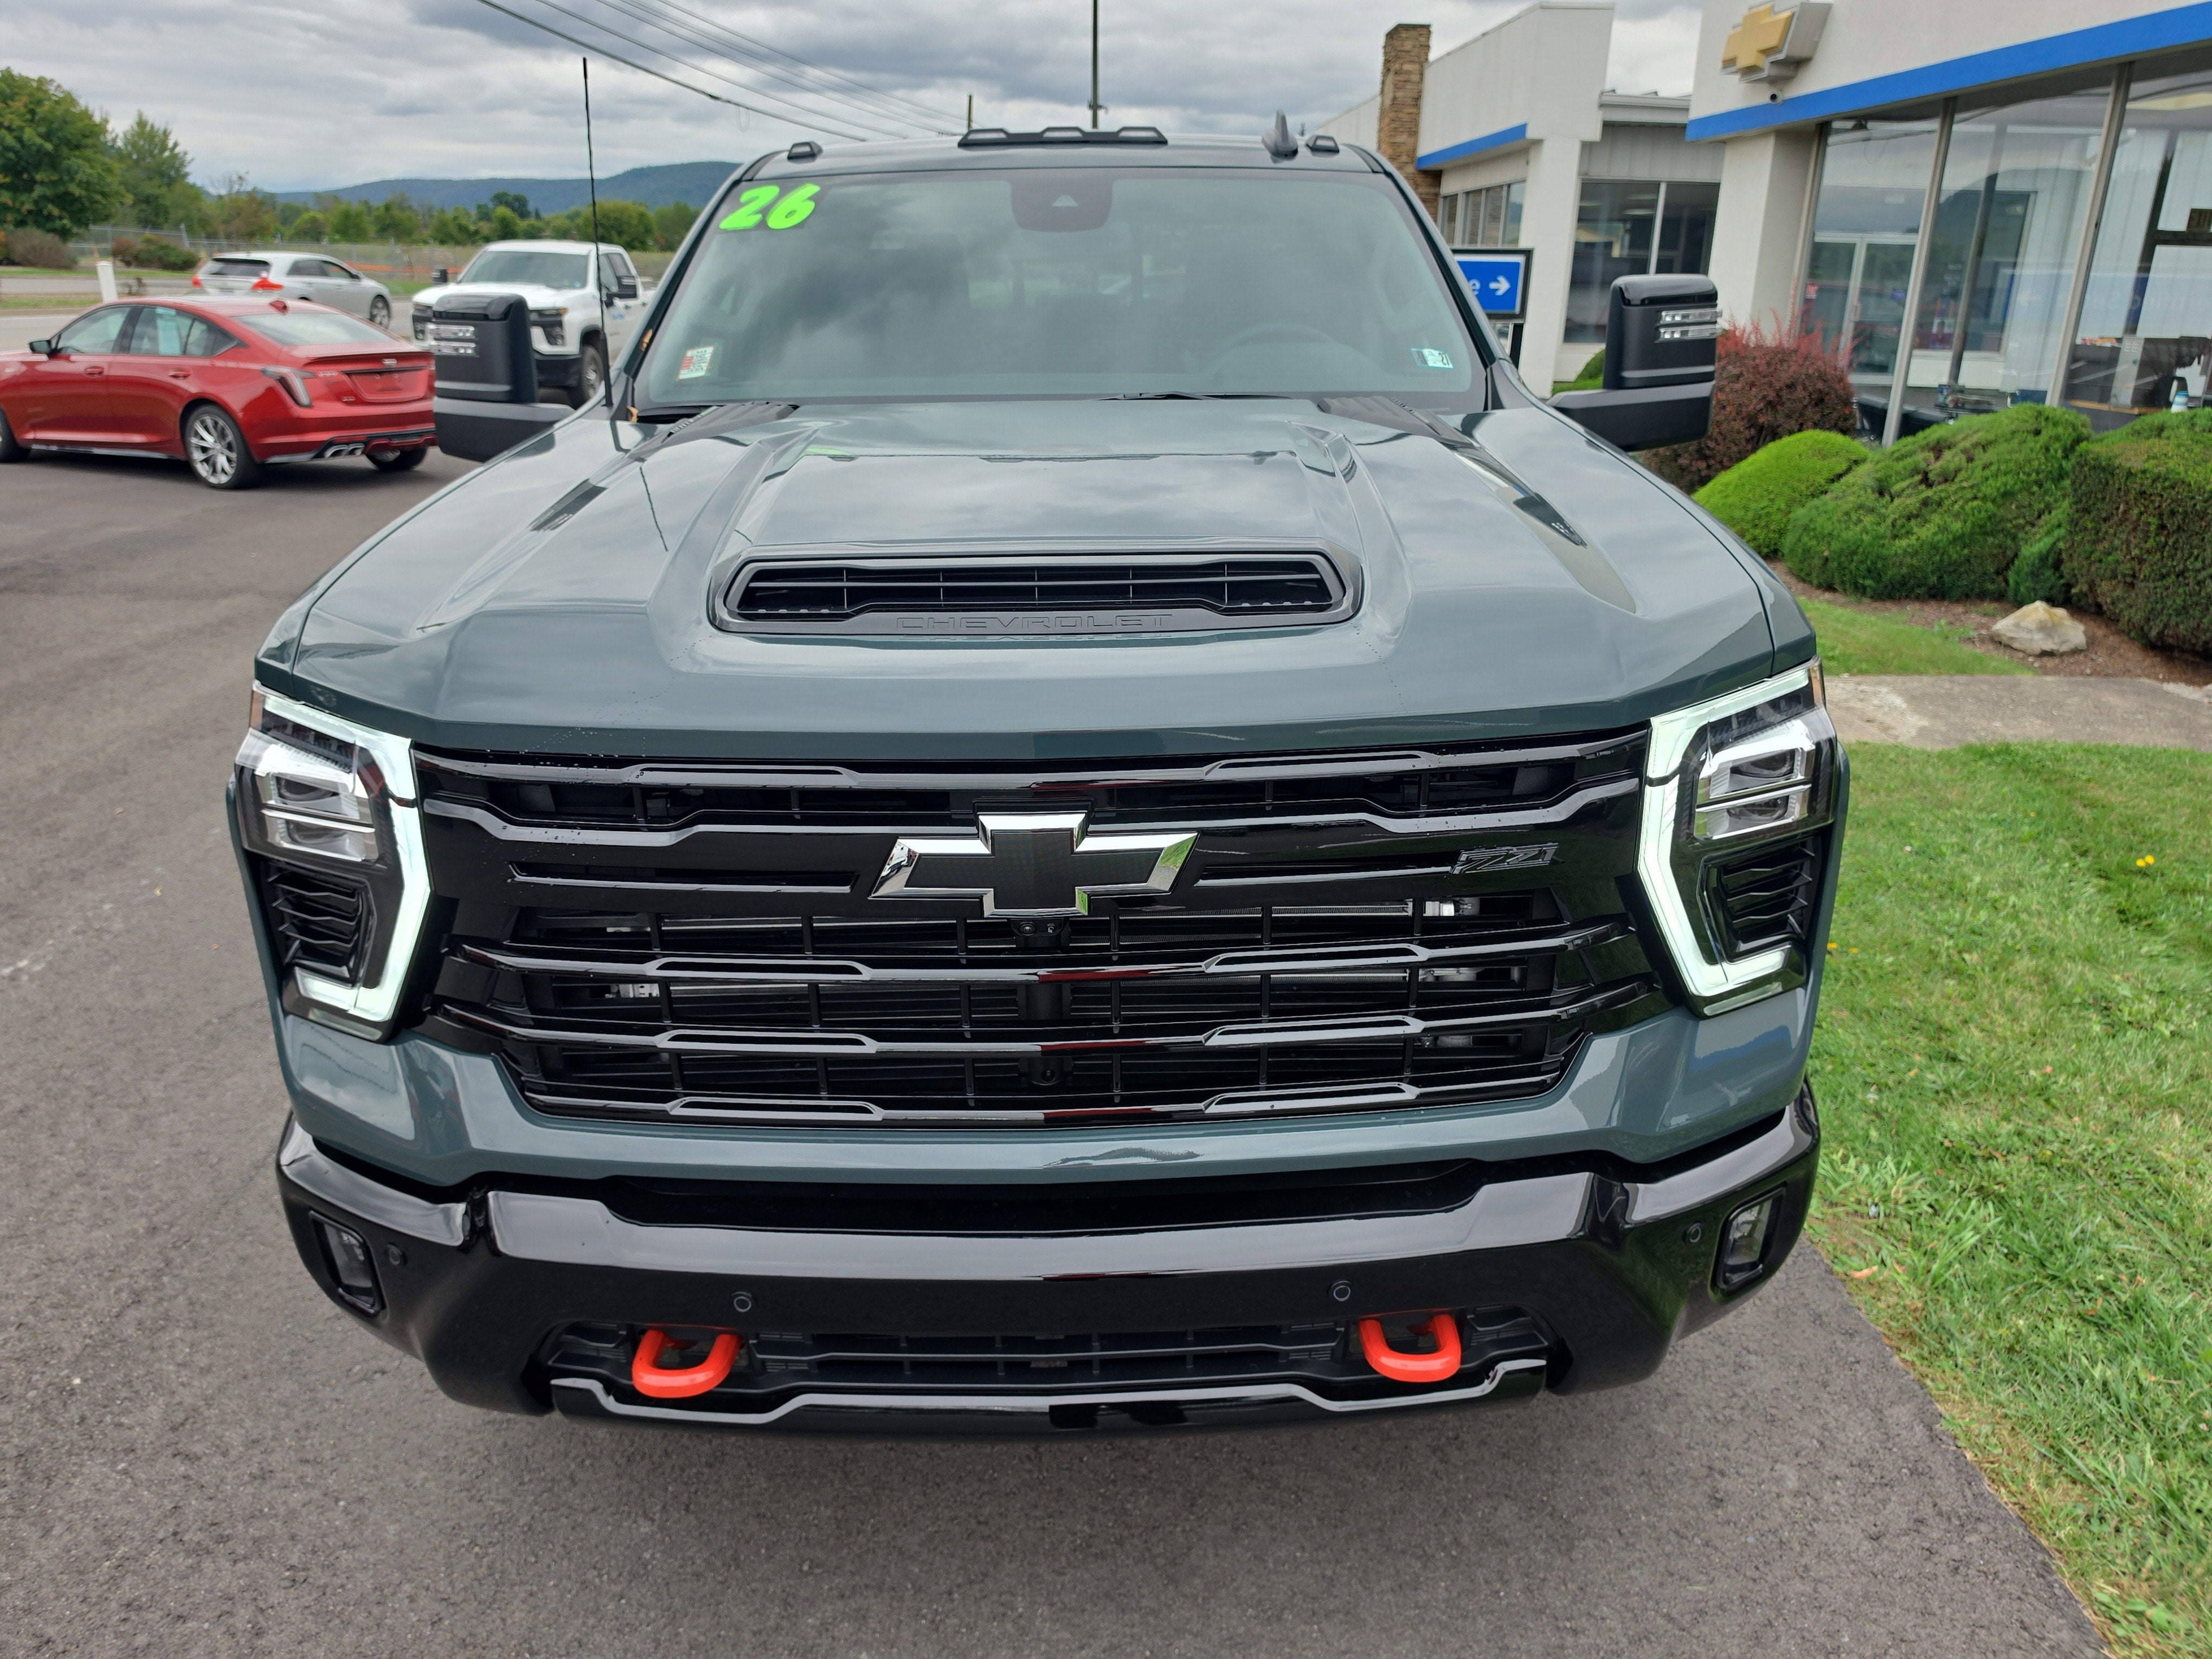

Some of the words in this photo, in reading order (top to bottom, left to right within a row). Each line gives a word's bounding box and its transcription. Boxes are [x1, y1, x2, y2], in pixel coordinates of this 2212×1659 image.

[719, 183, 821, 230] 26
[897, 614, 1173, 629] CHEVROLET
[1450, 843, 1559, 875] Z71
